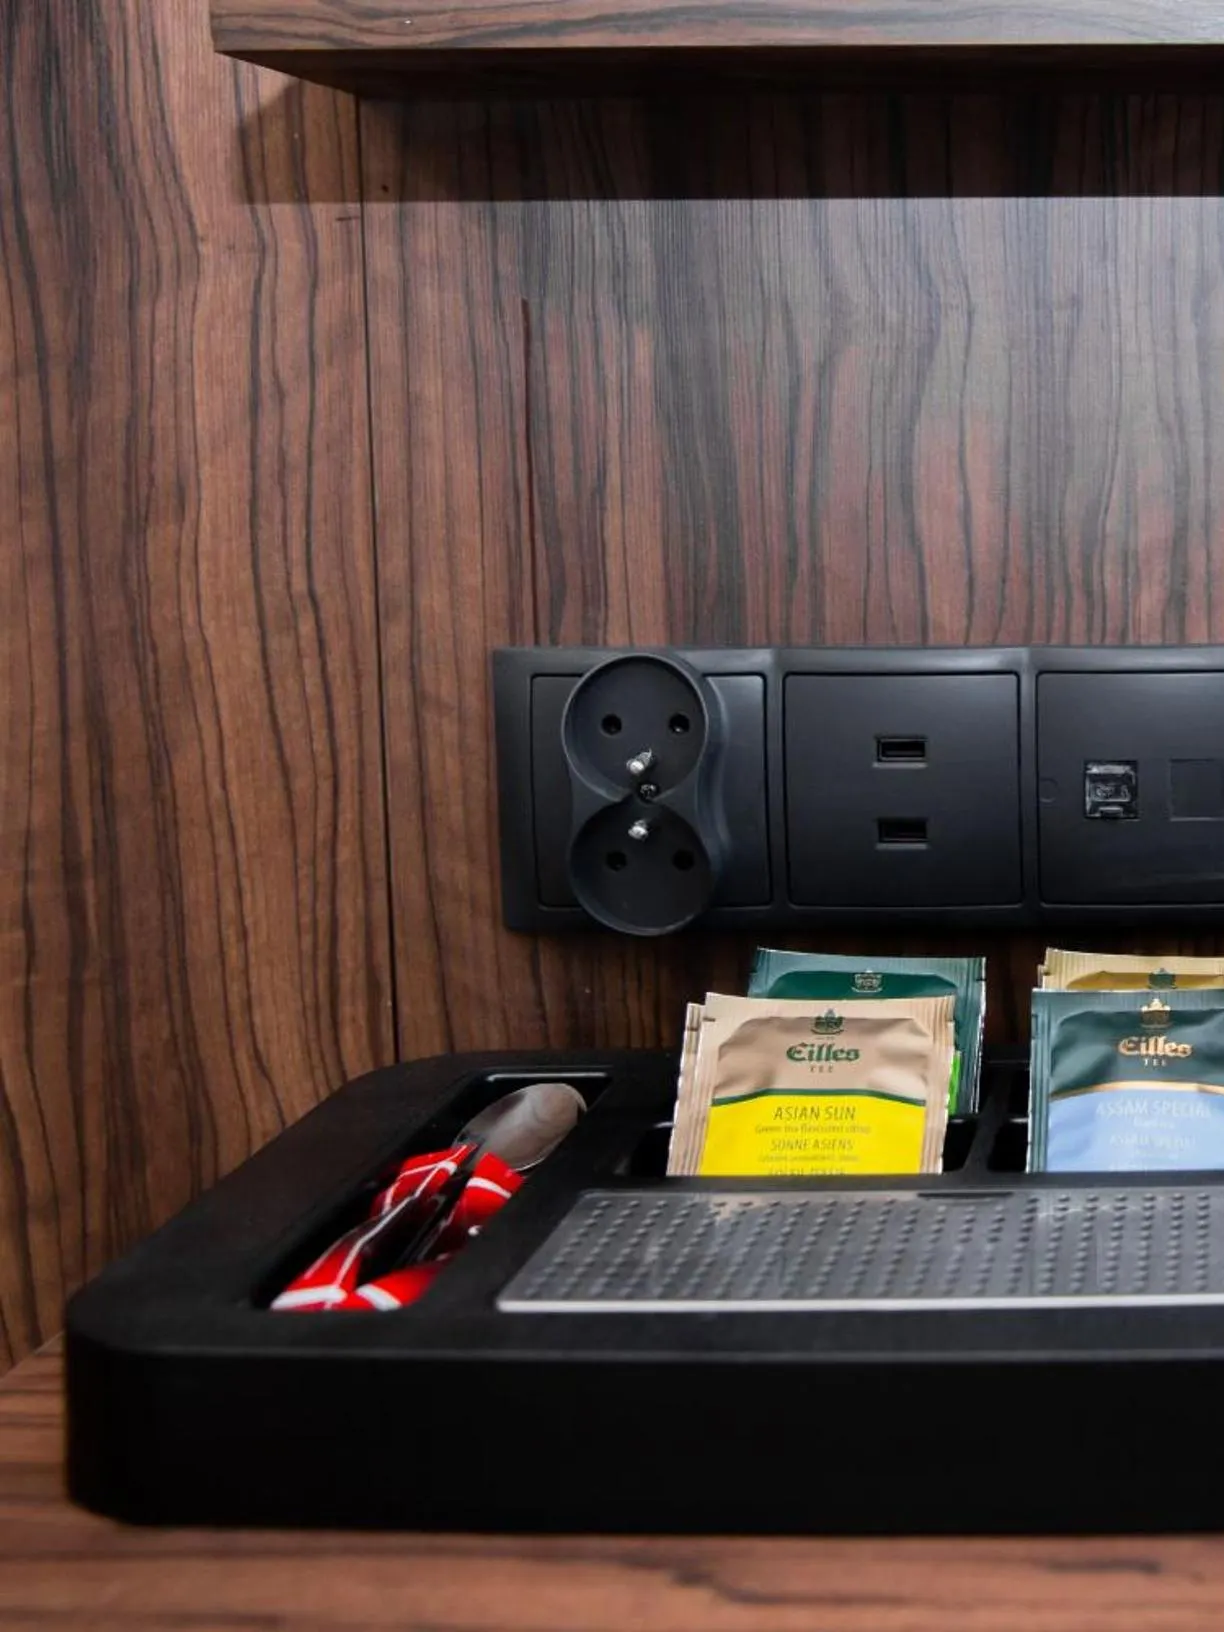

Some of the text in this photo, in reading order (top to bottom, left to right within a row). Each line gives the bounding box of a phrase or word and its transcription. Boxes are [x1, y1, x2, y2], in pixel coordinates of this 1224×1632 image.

[786, 1042, 860, 1062] Eilles
[1118, 1036, 1192, 1057] Eilles
[773, 1106, 856, 1121] ASIAN SUN
[1096, 1100, 1149, 1116] ASSAM
